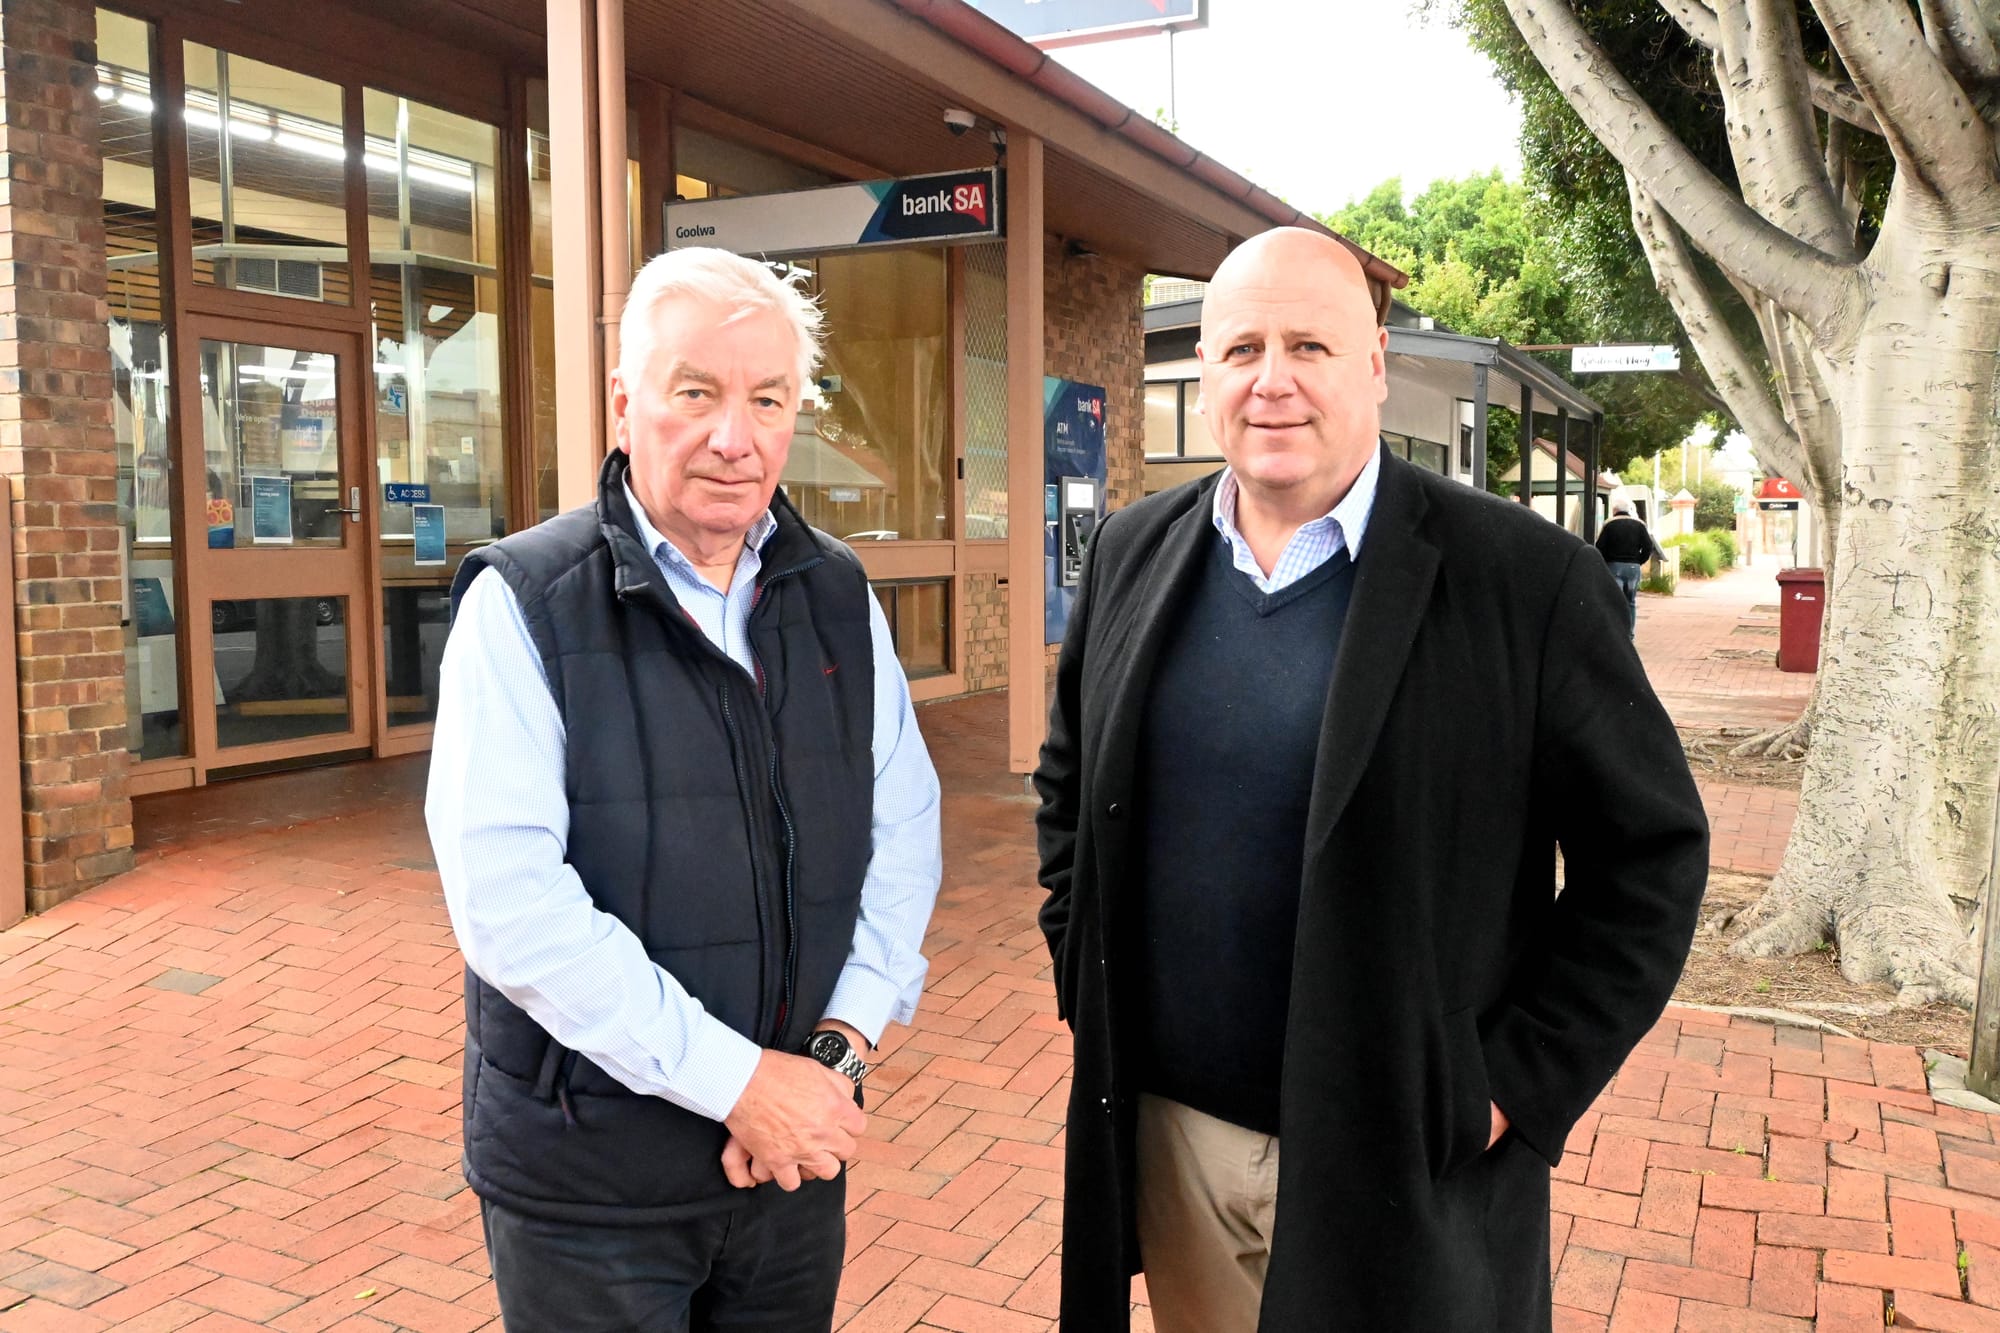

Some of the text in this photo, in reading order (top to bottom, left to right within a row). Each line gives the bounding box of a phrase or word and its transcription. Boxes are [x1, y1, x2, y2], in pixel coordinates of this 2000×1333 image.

[903, 187, 983, 215] bankSA
[676, 225, 715, 238] Goolwa
[1077, 397, 1101, 414] bankSA
[1056, 421, 1069, 434] ATM
[400, 489, 426, 499] ACCESS
